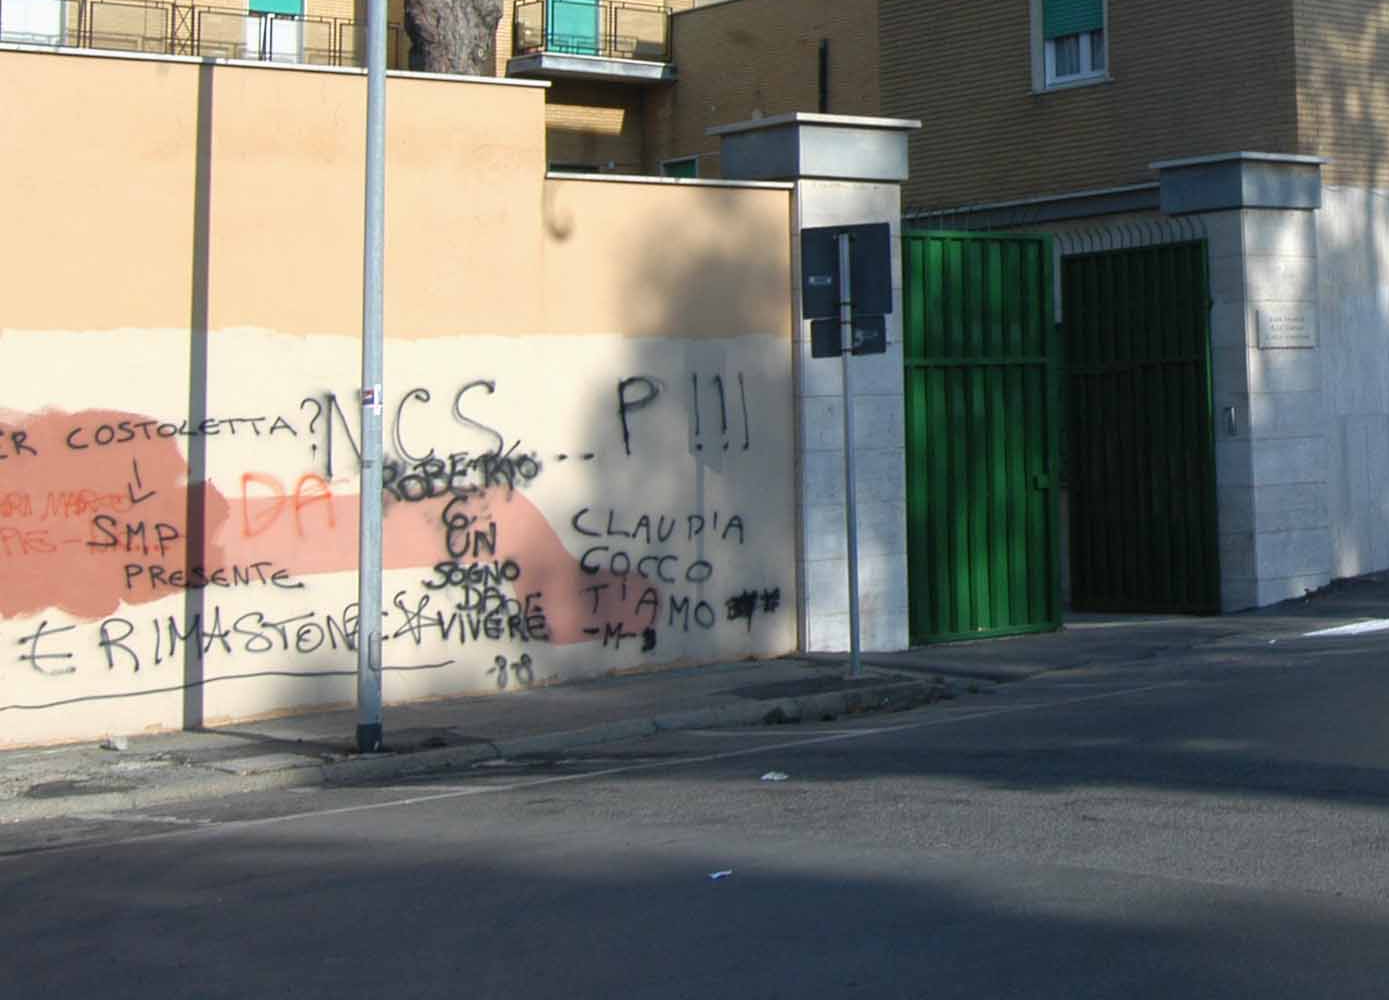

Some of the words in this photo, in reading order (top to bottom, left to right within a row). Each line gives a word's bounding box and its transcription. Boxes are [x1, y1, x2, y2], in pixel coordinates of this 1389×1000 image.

[86, 514, 180, 557] SMP
[571, 507, 744, 544] CLAUDIA
[124, 561, 306, 591] PRESENTE
[421, 559, 521, 589] SOGNO
[579, 546, 713, 584] COCCO
